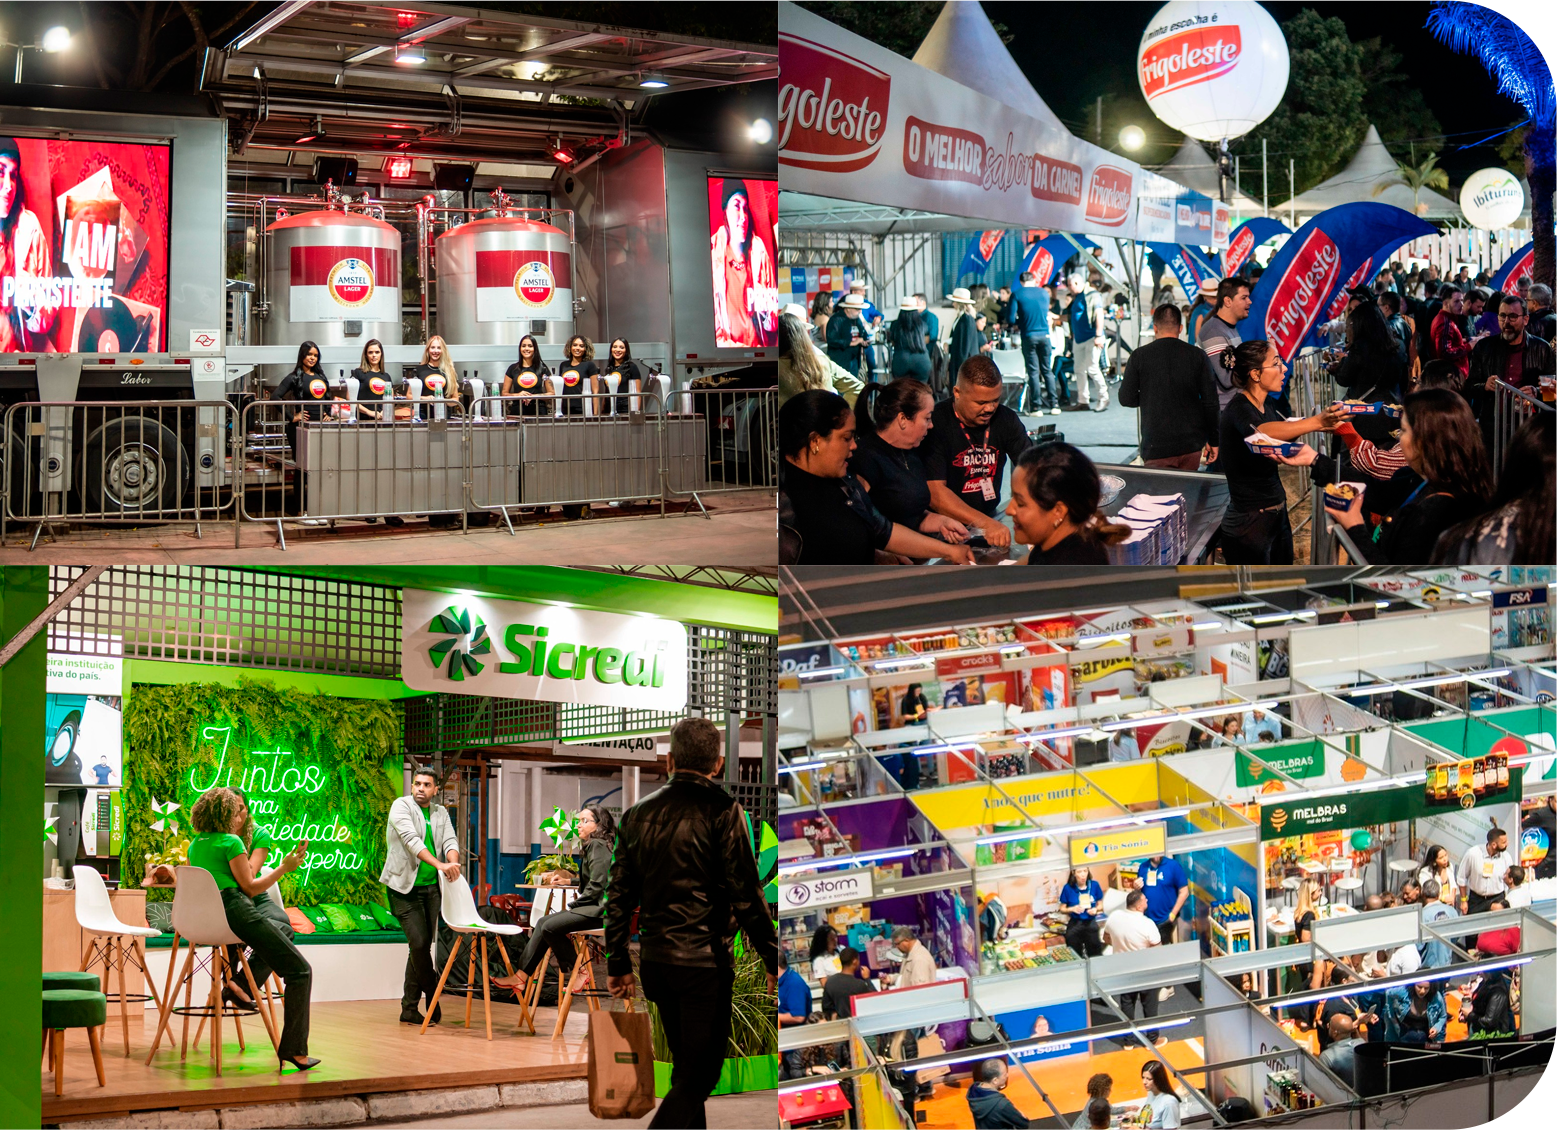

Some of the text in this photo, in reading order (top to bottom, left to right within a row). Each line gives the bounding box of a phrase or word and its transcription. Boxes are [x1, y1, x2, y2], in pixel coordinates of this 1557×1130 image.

[1147, 25, 1169, 41] minha
[1211, 12, 1218, 23] é
[778, 77, 882, 151] goleste
[908, 126, 1080, 199] O MELHOR sabor DA CARNE!
[74, 220, 117, 272] AM
[337, 276, 367, 285] AMSTEL
[523, 278, 549, 287] AMSTEL
[1266, 243, 1337, 348] Frigoleste
[120, 371, 154, 385] Labor
[963, 453, 996, 467] BACON
[500, 623, 669, 688] Sicredi
[65, 658, 115, 672] instituição
[65, 669, 78, 679] do
[79, 670, 102, 682] país.
[190, 726, 326, 793] Juntos
[1267, 756, 1314, 770] MELBRAS
[1018, 791, 1044, 807] que
[1047, 782, 1091, 801] nutre!
[113, 805, 121, 832] Sicredi
[1293, 803, 1347, 820] MELBRAS
[1102, 842, 1120, 853] Tia
[814, 876, 858, 894] storm
